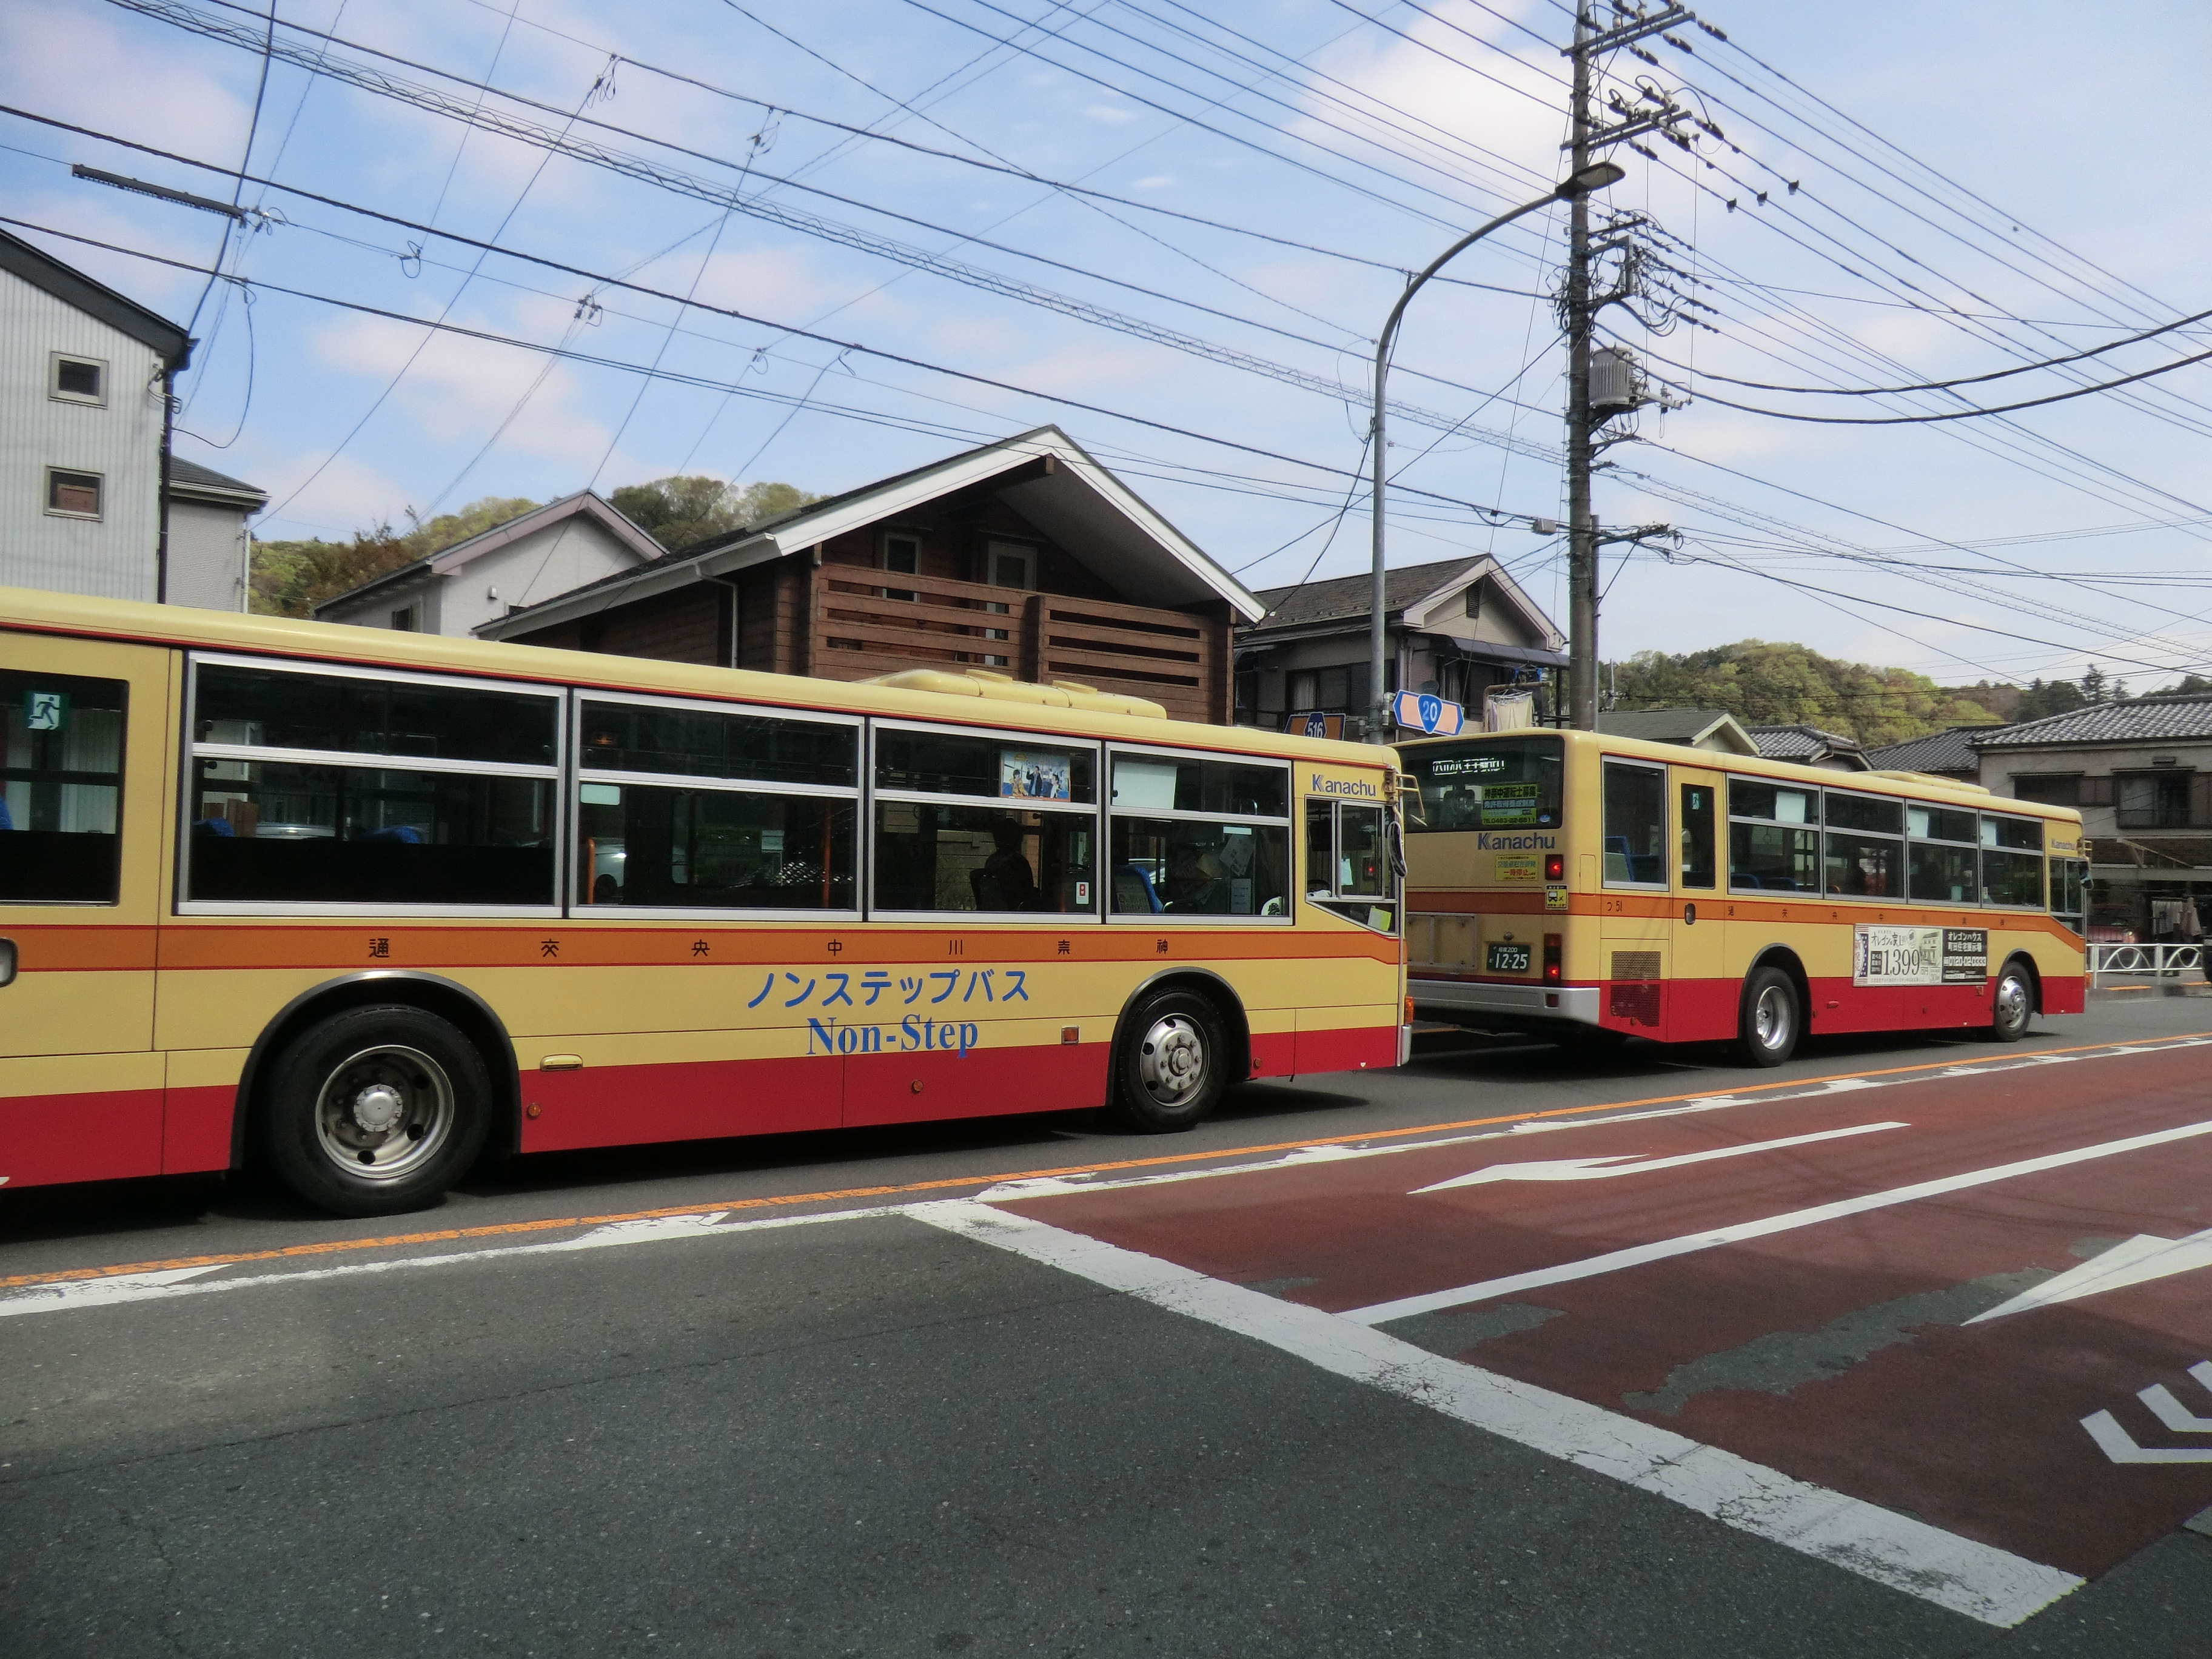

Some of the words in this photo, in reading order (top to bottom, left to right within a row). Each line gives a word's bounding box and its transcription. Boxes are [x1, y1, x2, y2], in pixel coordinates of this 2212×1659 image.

[1423, 700, 1438, 722] 20
[1307, 722, 1324, 738] 516
[1312, 774, 1376, 797] Kanachu
[1478, 832, 1556, 850] Kanachu
[1948, 932, 1982, 942] オレゴンハウス
[367, 939, 390, 958] 通
[540, 939, 560, 957] 交
[691, 939, 710, 957] 央
[828, 939, 842, 956] 中
[949, 939, 964, 955] 川
[1156, 939, 1168, 954] 神
[1495, 953, 1528, 969] 12-25
[748, 968, 1029, 1009] ノンステップバス
[806, 1014, 979, 1059] Non-Step
